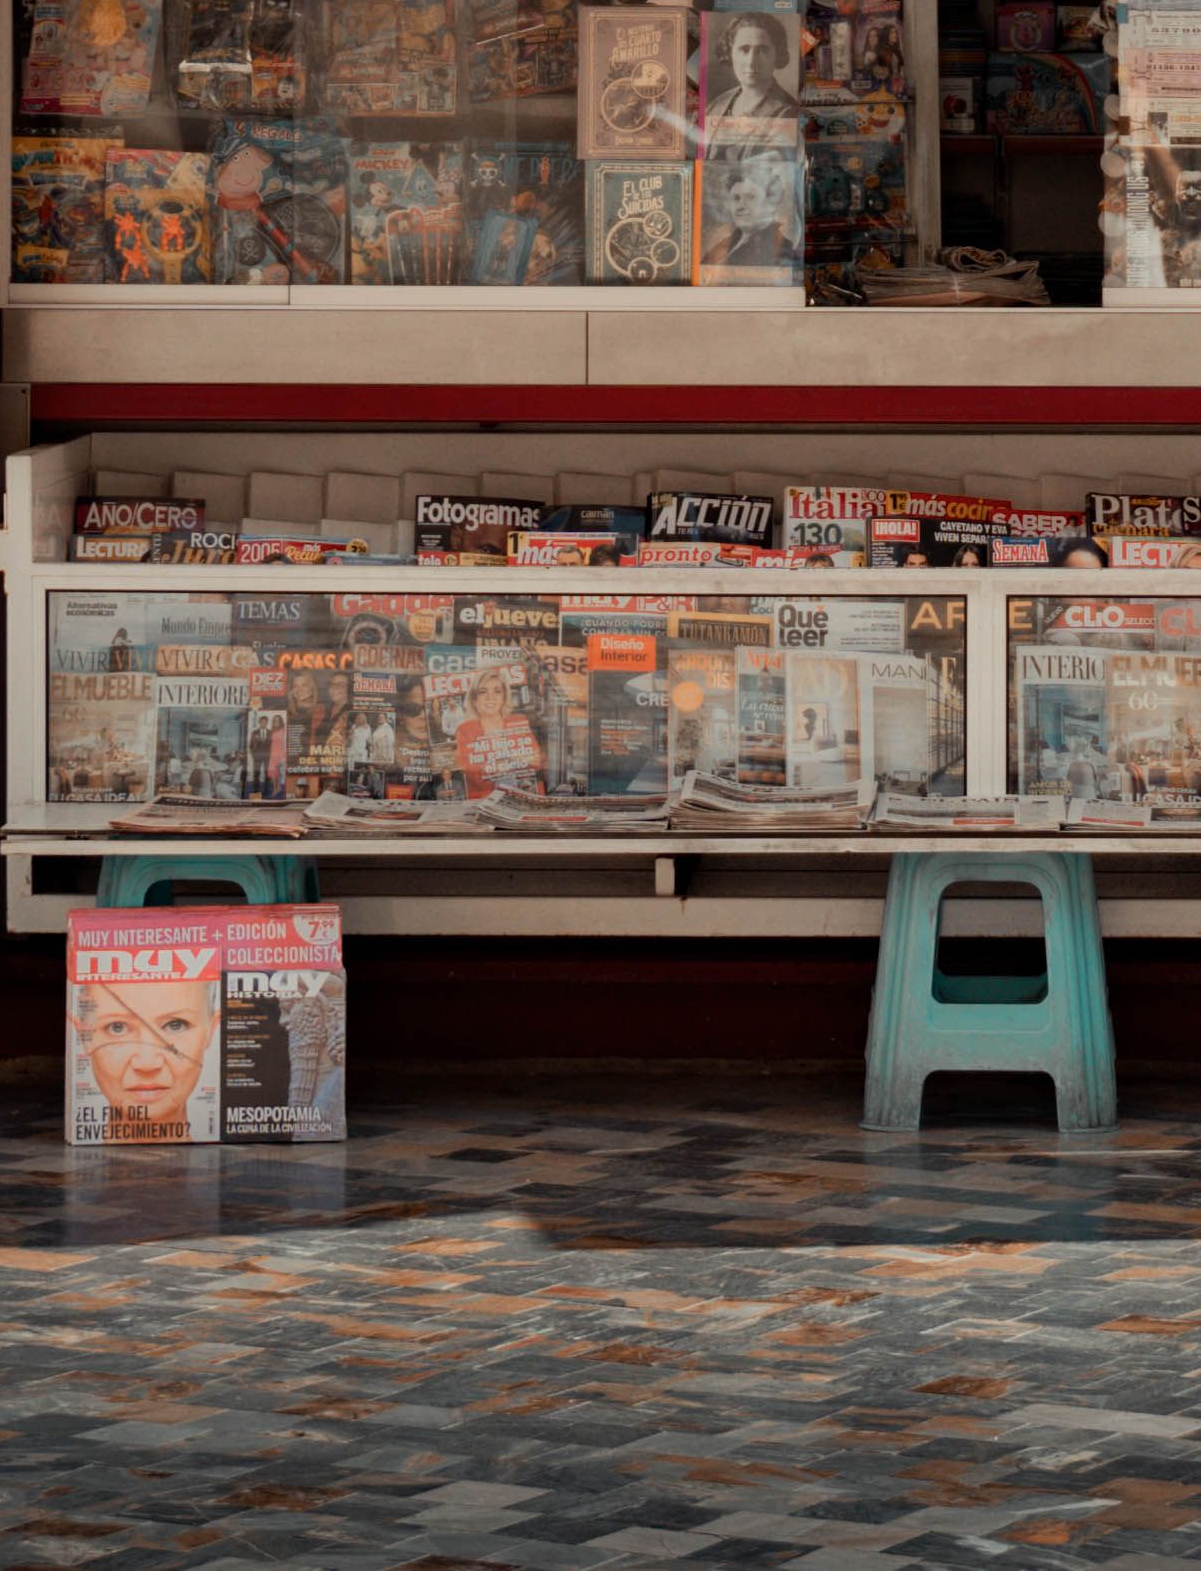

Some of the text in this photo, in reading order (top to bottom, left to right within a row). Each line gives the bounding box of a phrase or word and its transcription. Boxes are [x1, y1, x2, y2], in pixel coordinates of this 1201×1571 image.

[629, 31, 662, 46] CUARTO
[611, 44, 659, 66] AMARILLO
[355, 158, 410, 171] MICKEY
[623, 175, 663, 197] EL CLUB
[618, 197, 665, 218] SUICIDAS
[84, 502, 198, 530] AÑO/CERO
[416, 496, 540, 530] Fotogramas
[907, 495, 946, 518] más
[873, 520, 919, 540] ¡HOLA!
[939, 520, 981, 534] CAYETANO
[983, 522, 990, 534] Y
[991, 523, 1008, 535] EVA
[994, 511, 1067, 531] SABER
[792, 521, 843, 547] 130
[934, 531, 961, 544] VIVEN
[641, 547, 713, 565] pronto
[992, 539, 1050, 563] SEMANA
[65, 608, 116, 617] económicas
[66, 600, 118, 610] Alternativas
[237, 600, 300, 620] TEMAS
[459, 602, 559, 629] el jueve
[778, 604, 829, 629] Qué
[161, 617, 197, 636] Mundo
[680, 622, 767, 644] TUTANKAMÓN
[600, 636, 645, 650] Diseño
[778, 628, 829, 647] leer
[56, 648, 109, 671] VIVIR
[160, 648, 213, 670] VIVIR
[357, 645, 424, 669] COCINAS
[600, 651, 648, 662] Interior
[50, 674, 153, 701] EL MUEBLE
[253, 672, 283, 685] DIEZ
[354, 675, 397, 693] SEMANA
[490, 738, 532, 753] hijo se
[298, 756, 317, 765] DEL
[469, 753, 486, 763] ha
[78, 921, 287, 947] MUY INTERESANTE + EDICIÓN
[77, 948, 216, 979] muy
[226, 945, 342, 966] COLECCIONISTA
[77, 972, 182, 981] INTERESANTE
[227, 971, 331, 998] muy
[227, 990, 303, 999] HISTORIA
[75, 1105, 151, 1123] ¿EL FIN DEL
[226, 1106, 322, 1122] MESOPOTAMIA
[75, 1121, 192, 1140] ENVEJECIMIENTO?
[226, 1122, 333, 1134] LA CUNA DE LA CIVILIZACIÓN
